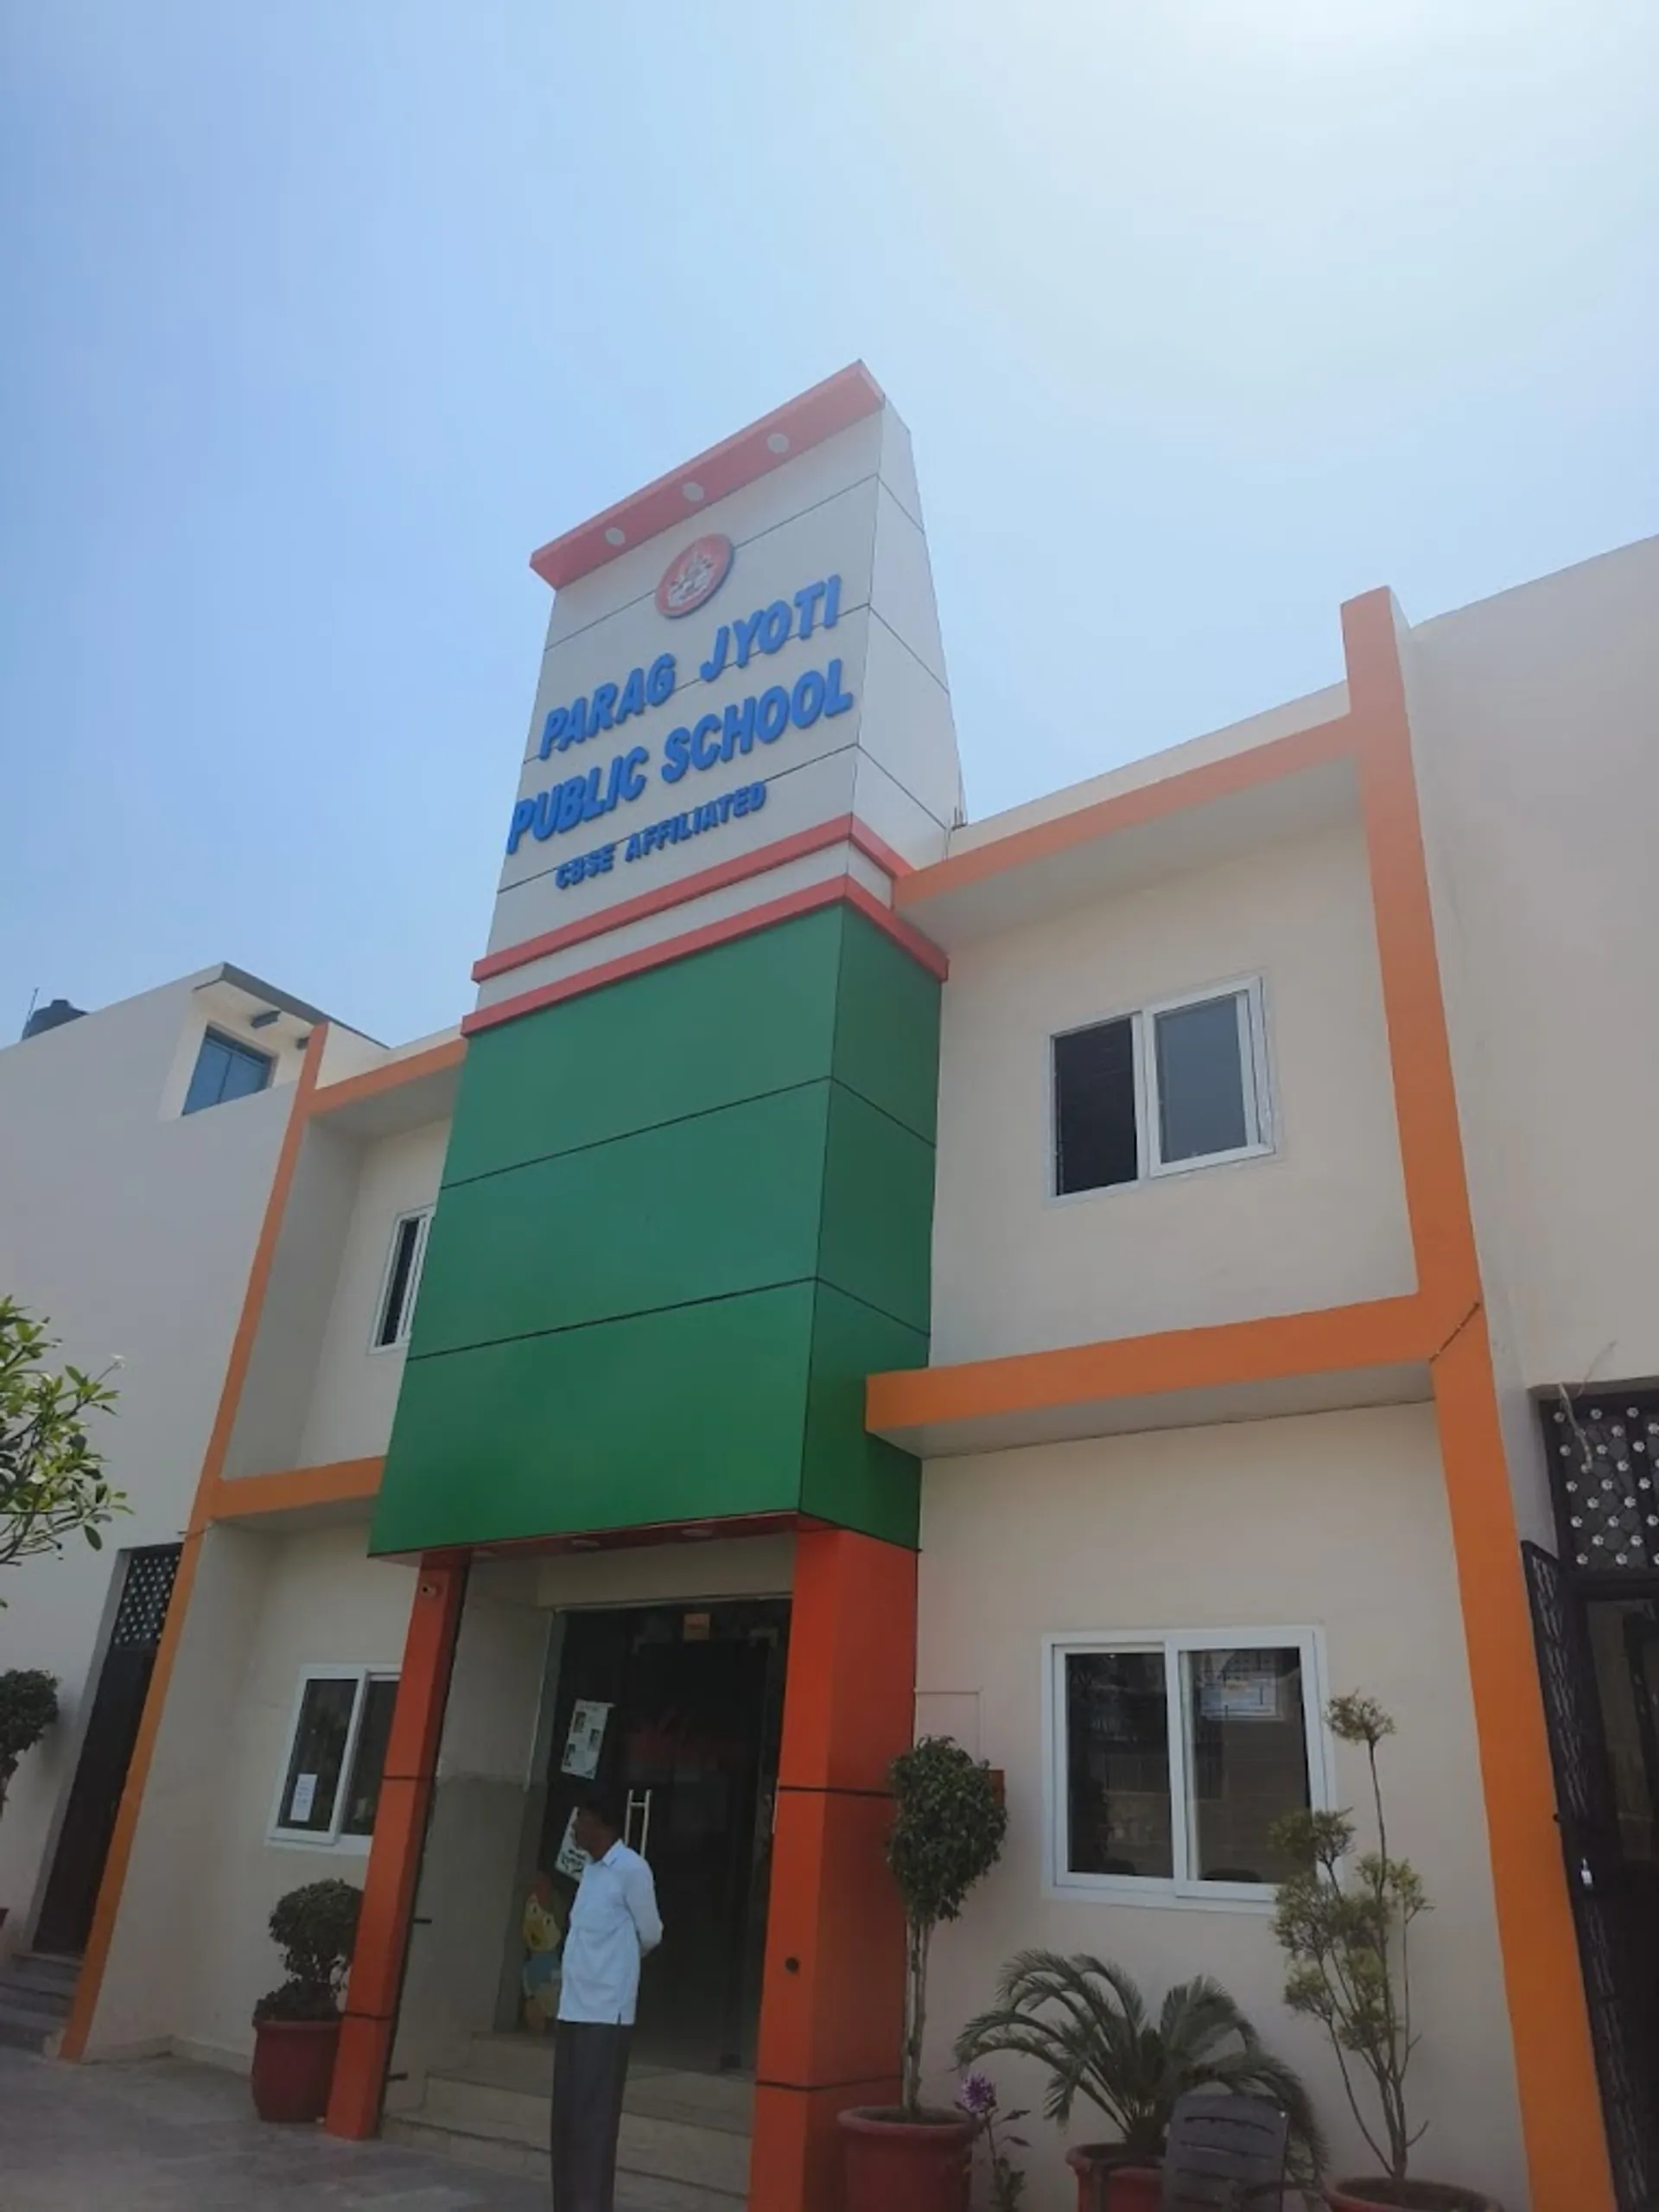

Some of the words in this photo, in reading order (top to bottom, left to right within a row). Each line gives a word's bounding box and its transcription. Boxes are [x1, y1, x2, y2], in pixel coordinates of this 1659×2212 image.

[506, 747, 649, 855] PUBLIC
[661, 658, 854, 783] SCHOOL
[538, 653, 677, 760] PARAG
[700, 575, 841, 682] JYOTI
[556, 843, 615, 889] CBSE
[625, 781, 766, 862] AFFILIATED
